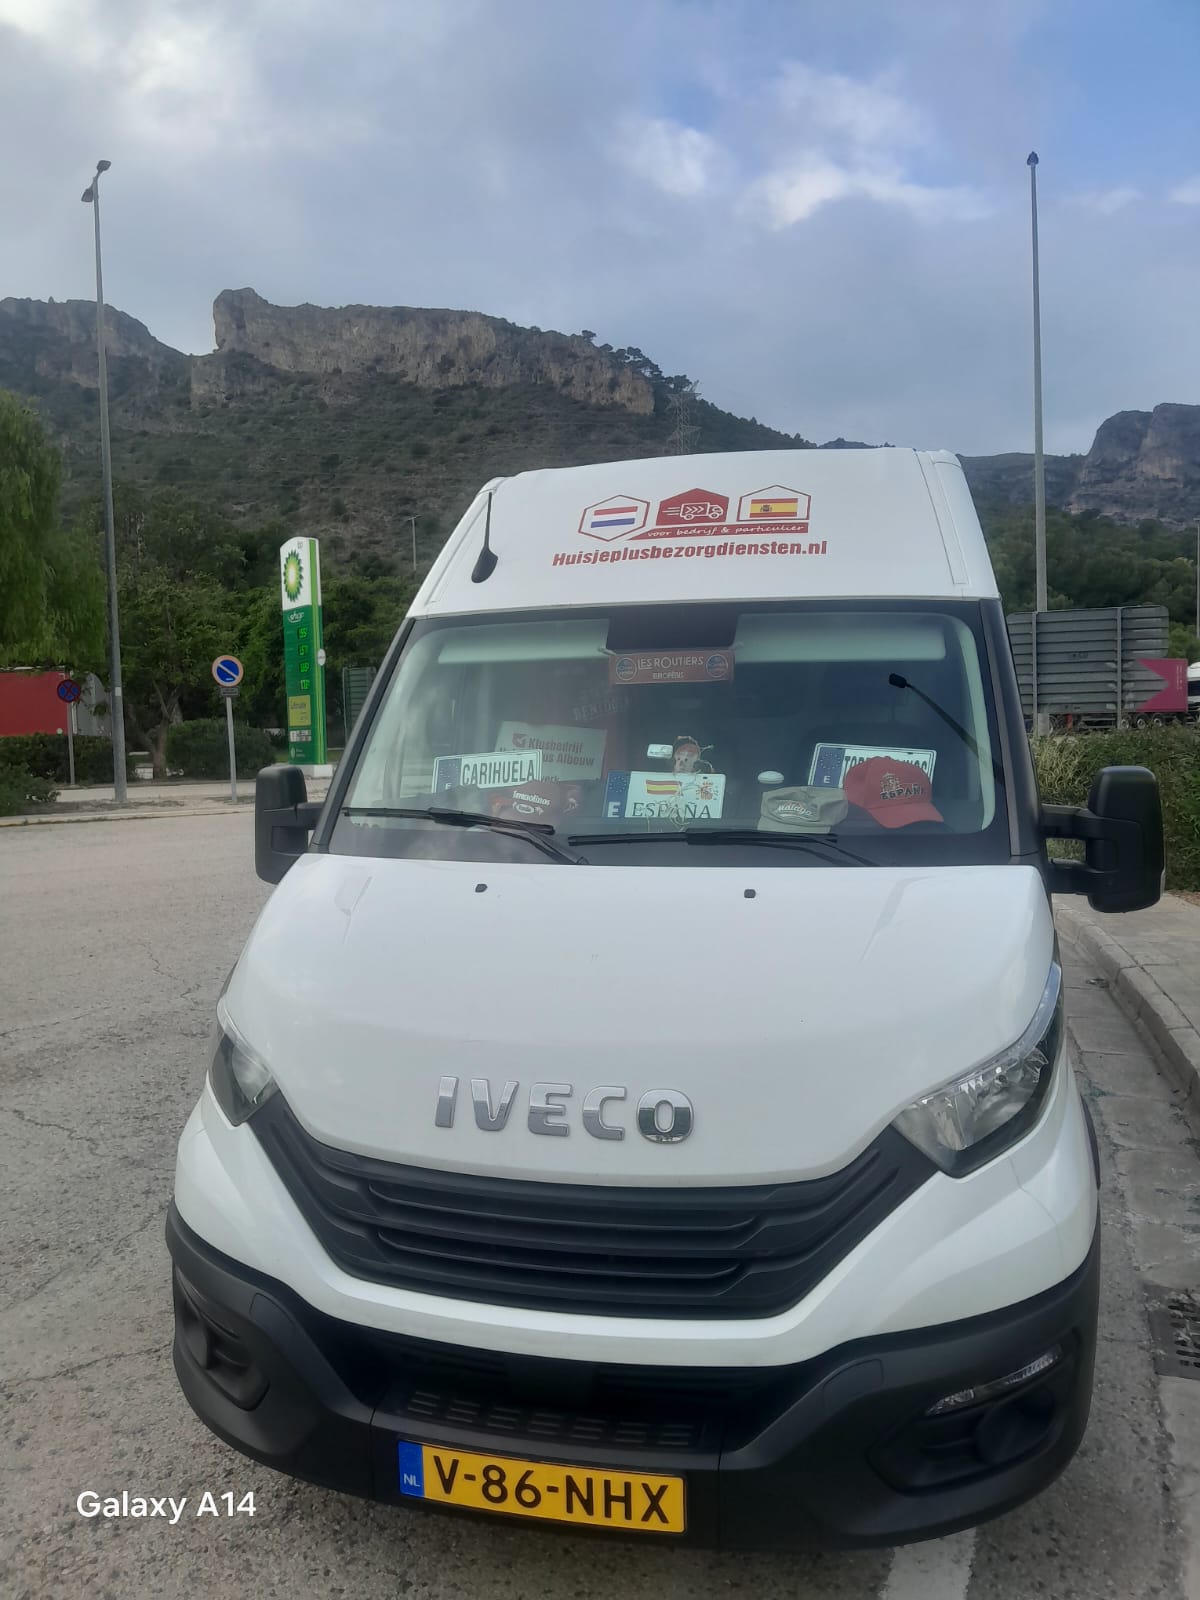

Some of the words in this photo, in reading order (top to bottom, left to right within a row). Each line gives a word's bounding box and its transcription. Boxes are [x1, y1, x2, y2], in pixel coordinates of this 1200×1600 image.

[676, 527, 717, 536] bedrijf
[720, 526, 729, 534] &
[735, 525, 804, 534] particulier
[552, 541, 827, 566] Huisjeplusbezorgdiensten.nl
[638, 657, 652, 669] LES
[654, 656, 704, 669] ROUTIERS
[462, 760, 535, 785] CARIHUELA
[823, 776, 831, 784] E
[607, 801, 620, 818] E
[631, 801, 711, 819] ESPAÑA
[434, 1076, 694, 1144] IVECO
[403, 1474, 420, 1487] NL
[433, 1455, 669, 1524] V-86-NHX
